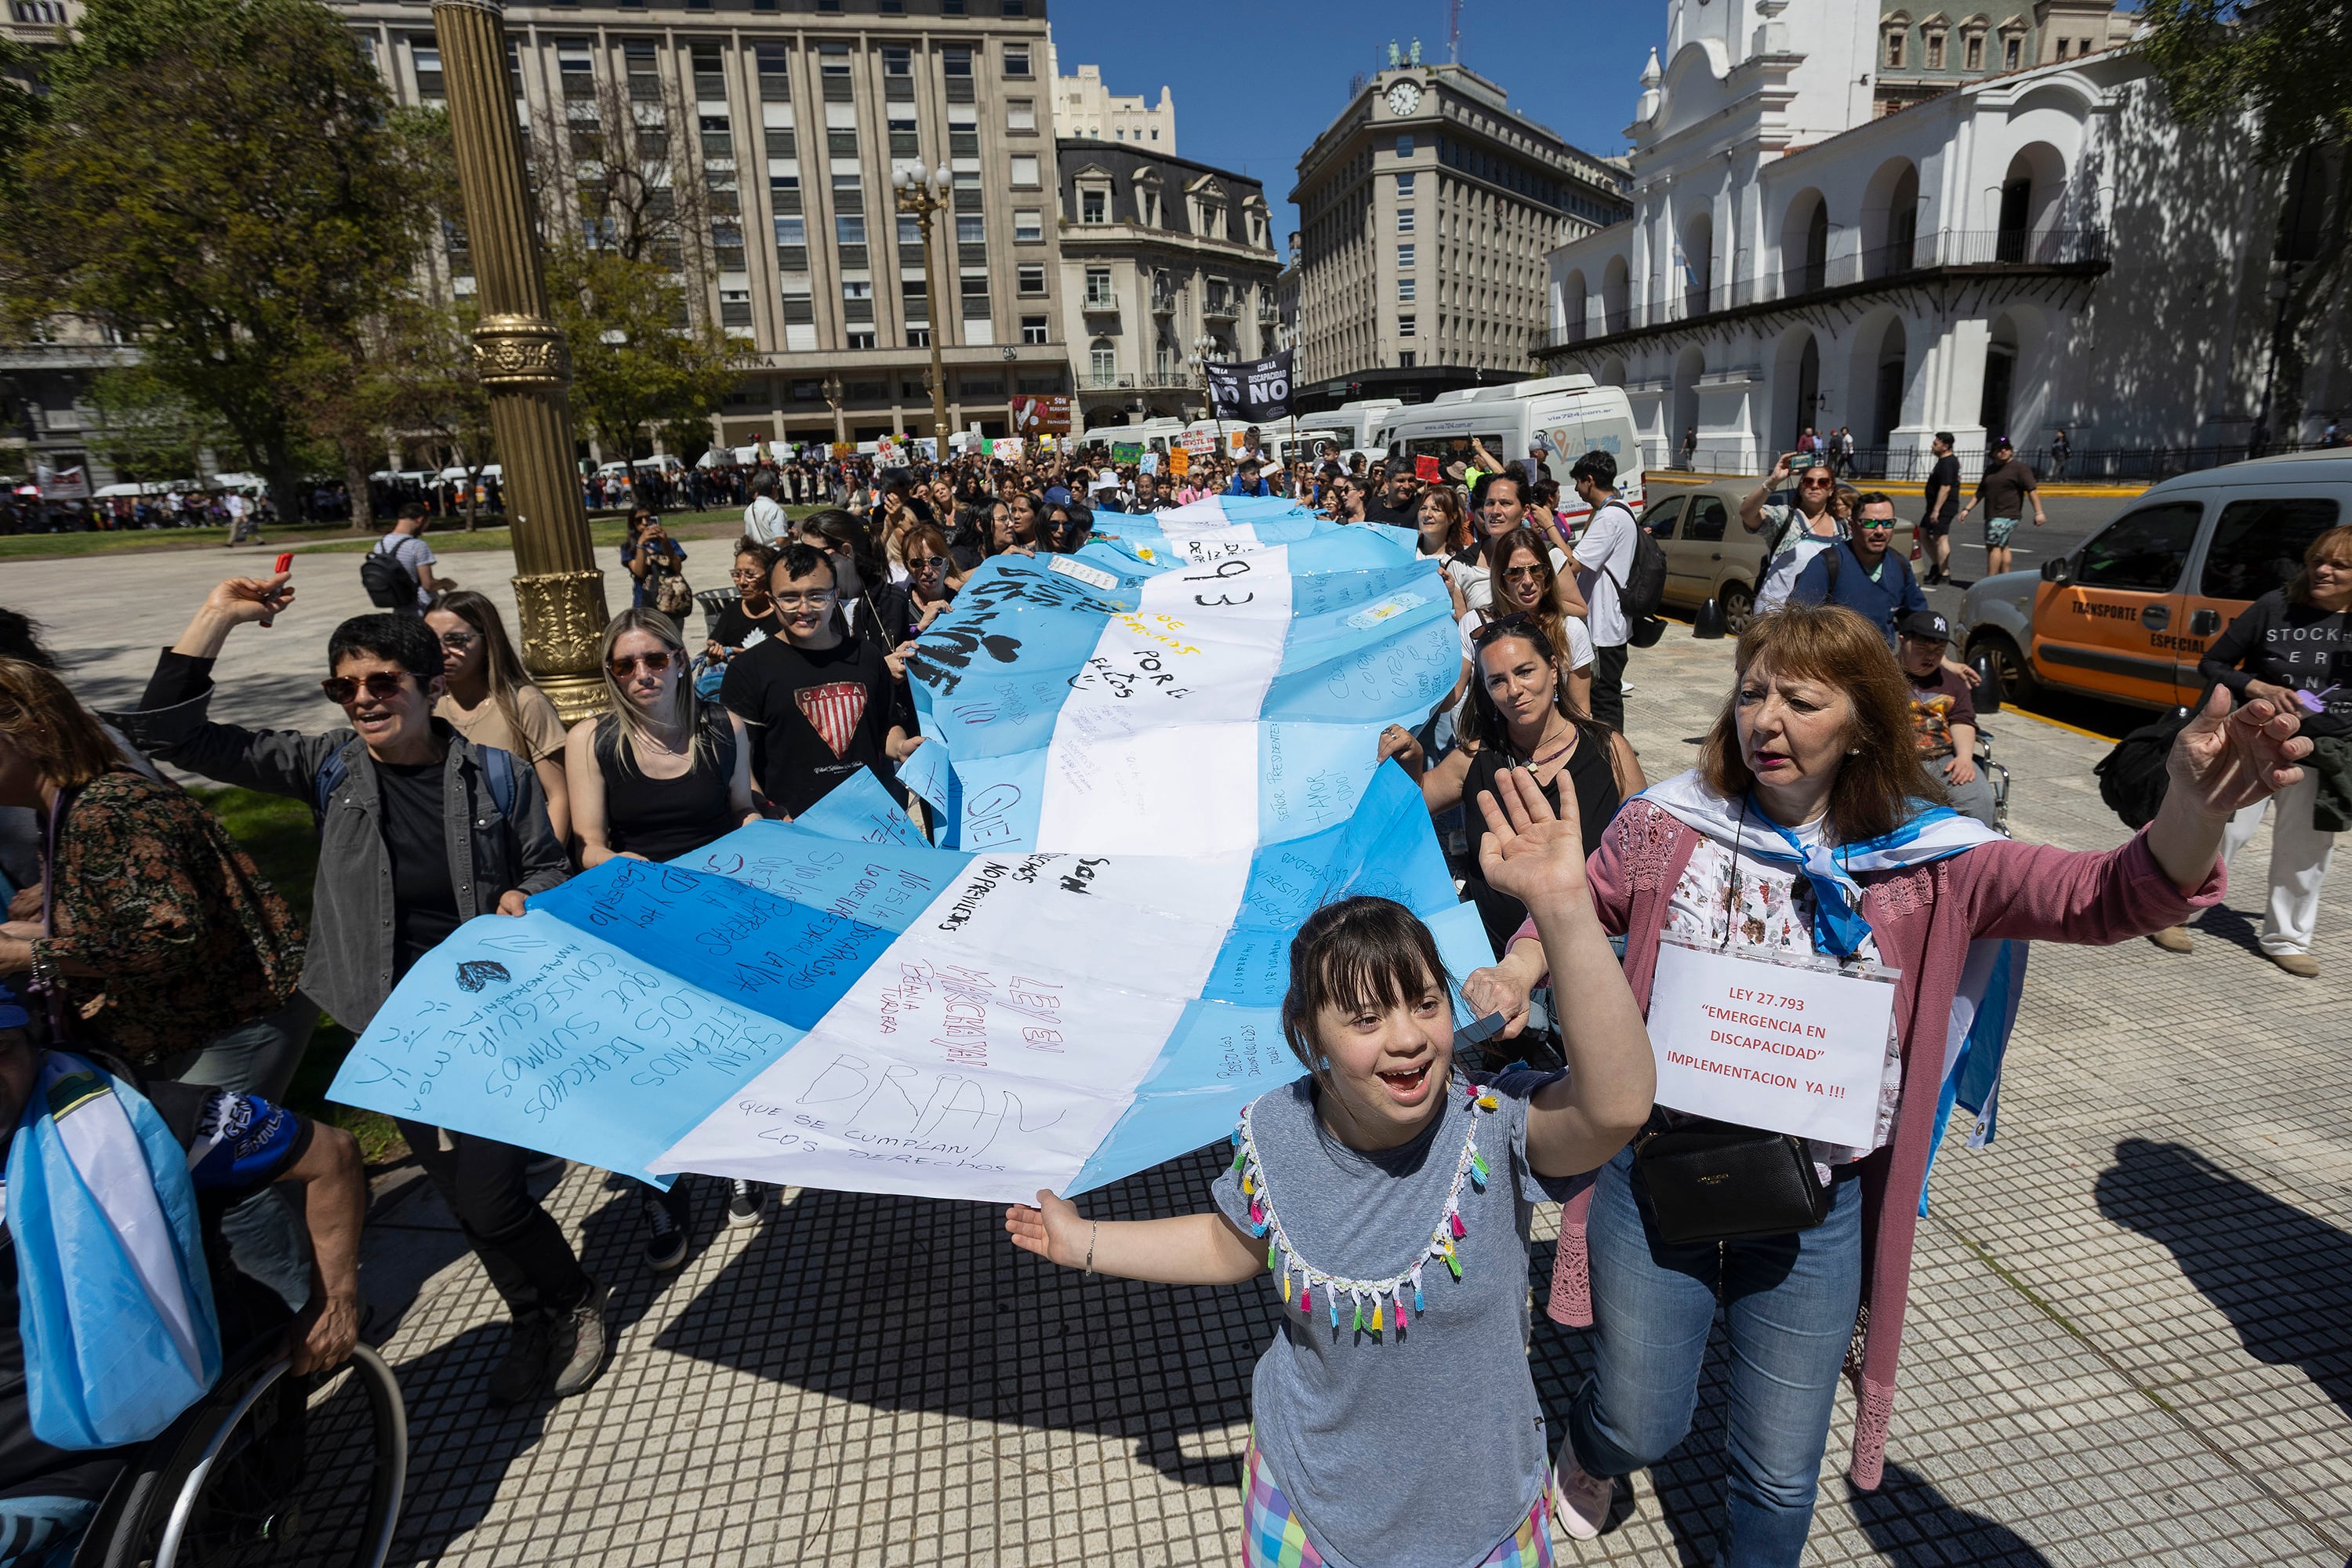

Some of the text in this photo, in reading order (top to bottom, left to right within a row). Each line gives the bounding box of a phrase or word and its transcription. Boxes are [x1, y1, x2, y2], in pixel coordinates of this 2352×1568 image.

[1248, 369, 1287, 383] DISCAPACIDAD
[1258, 363, 1268, 372] CON
[1210, 383, 1240, 404] NO
[1249, 379, 1288, 404] NO
[878, 442, 891, 452] NO
[876, 458, 905, 470] VETO
[2071, 601, 2137, 622] TRANSPORTE
[2151, 633, 2206, 654] ESPECIAL
[1133, 651, 1174, 686] POR
[1306, 769, 1331, 808] AMOR
[1269, 789, 1290, 822] SEÑOR
[898, 869, 931, 891] NO
[982, 861, 1009, 879] NO
[885, 887, 912, 905] ES
[1248, 891, 1298, 926] BASTA
[868, 904, 905, 919] LA
[601, 968, 660, 1014] QUE
[996, 975, 1063, 1024] LEY
[1729, 986, 1805, 1011] LEY 27.793
[470, 951, 616, 1058] CONSEGUIR
[1806, 1025, 1827, 1039] EN
[524, 988, 710, 1123] LOS DERECHOS
[631, 1006, 747, 1087] ETERNOS
[707, 1025, 783, 1076] SEAN
[1667, 1050, 1846, 1098] IMPLEMENTACION YA !!!
[739, 1099, 969, 1154] QUE SE CUMPLAN
[757, 1127, 818, 1152] LOS
